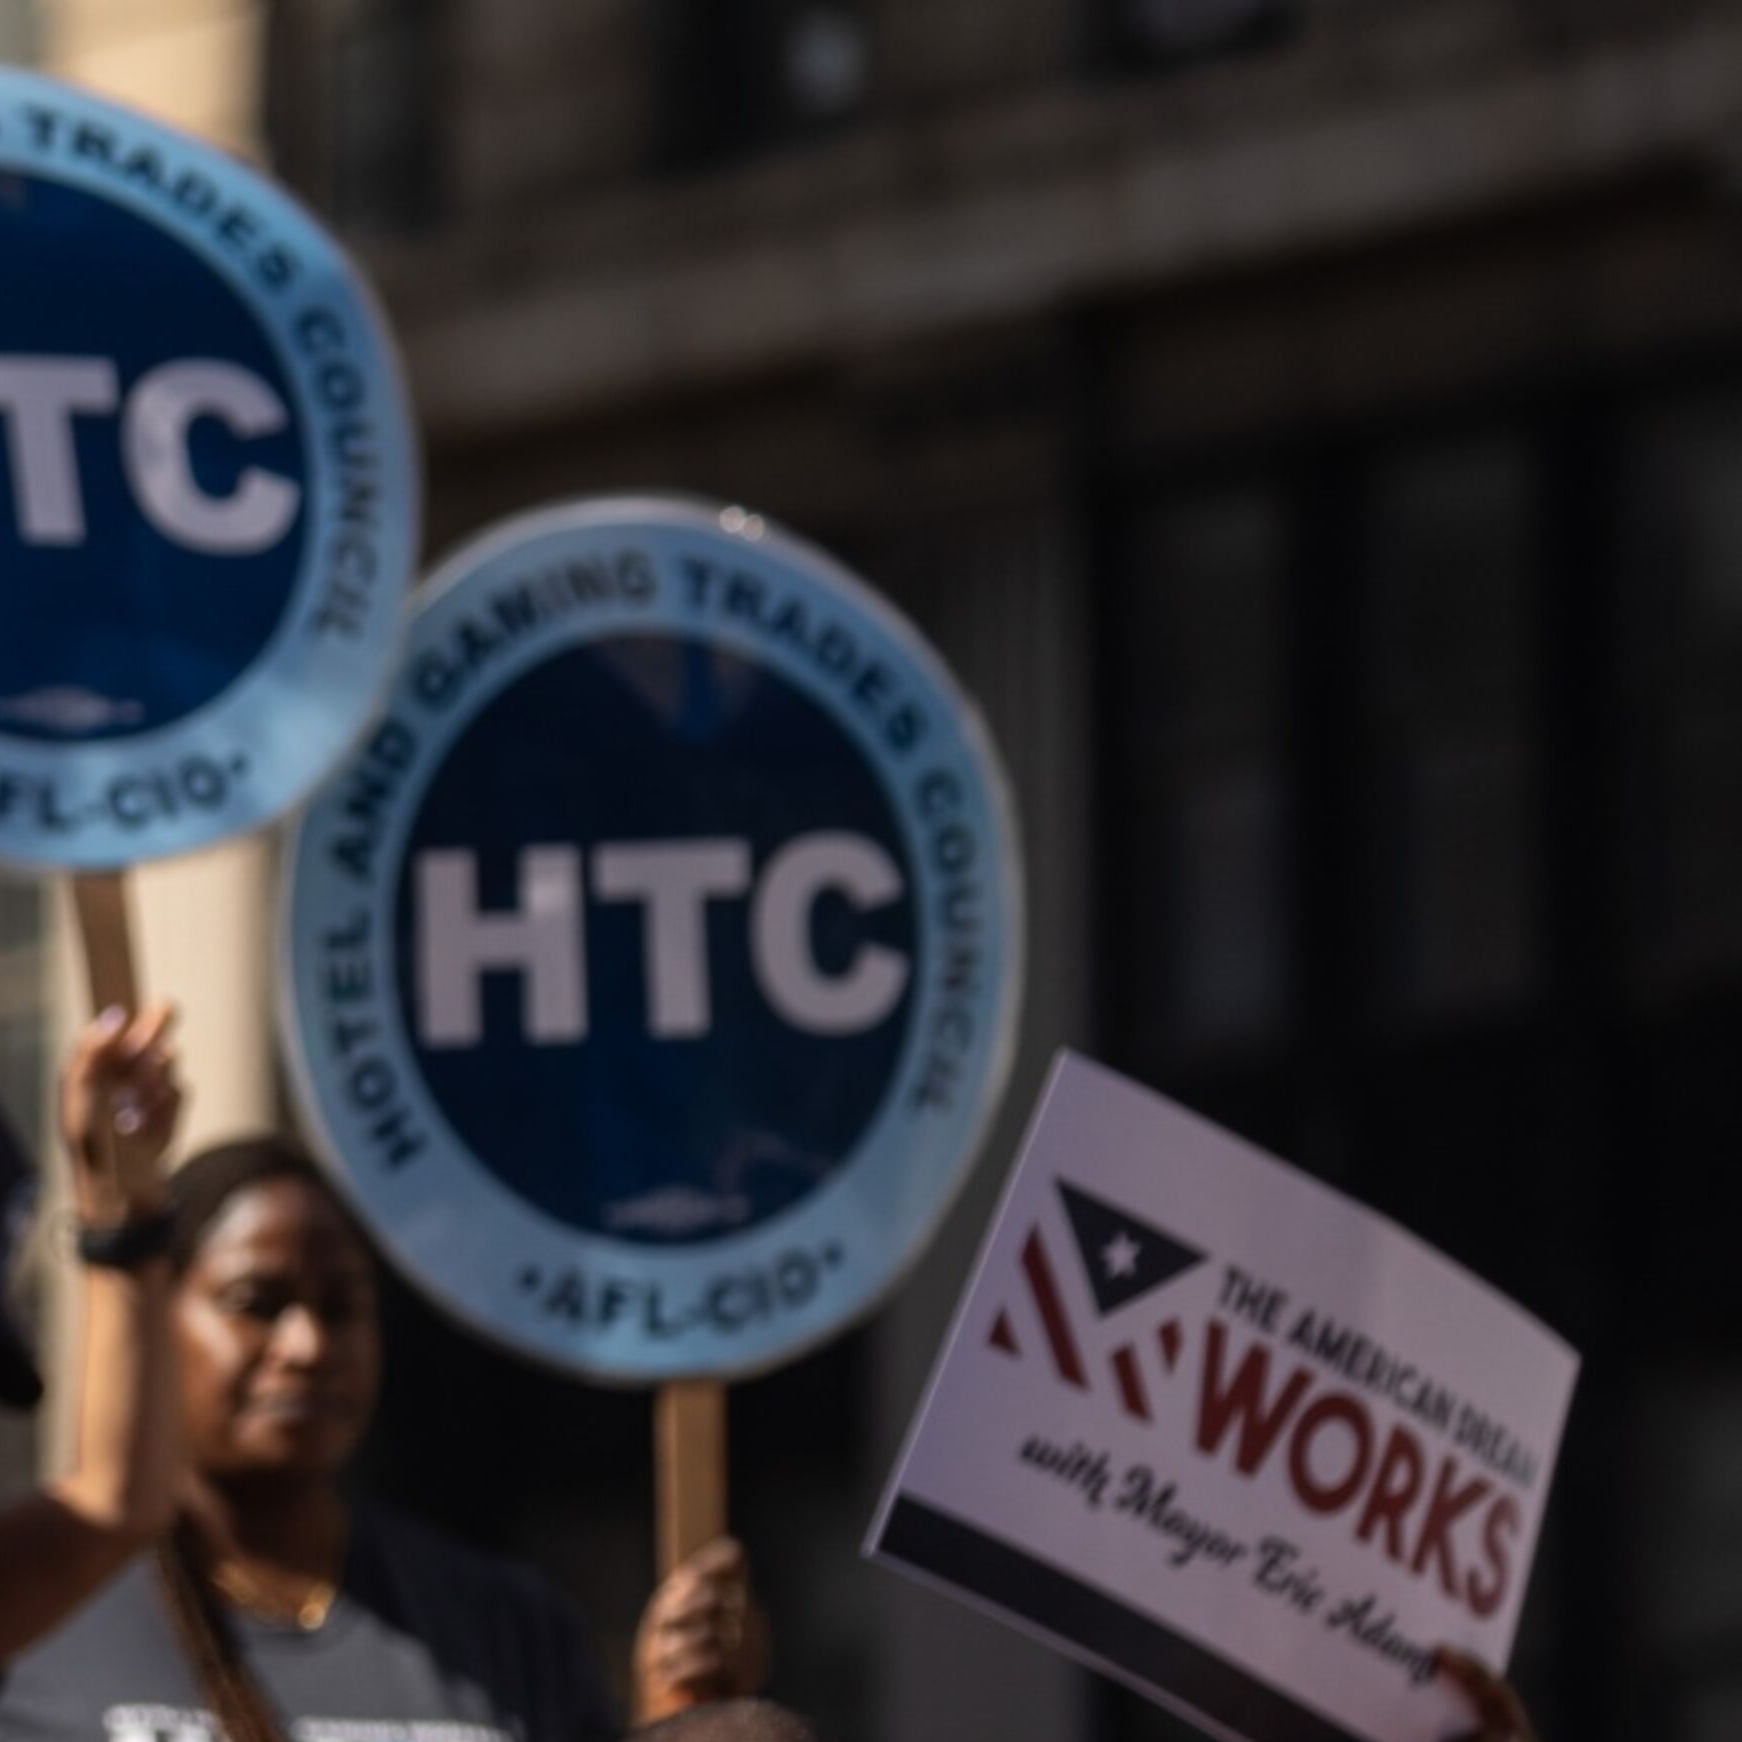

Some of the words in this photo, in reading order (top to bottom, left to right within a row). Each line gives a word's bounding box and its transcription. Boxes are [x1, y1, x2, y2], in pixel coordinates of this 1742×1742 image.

[21, 104, 300, 293] TRADES
[293, 303, 387, 643] COUNCIL
[414, 548, 658, 706] GAMING
[678, 554, 930, 762] TRADES
[331, 715, 420, 881] AND
[322, 898, 430, 1174] HOTEL
[409, 829, 910, 1048] HTC
[914, 768, 982, 1116] COUNCIL
[548, 1250, 830, 1343] AFL-CIO
[1215, 1264, 1290, 1328] THE
[1289, 1304, 1458, 1440] AMERICAN
[1018, 1428, 1114, 1509] with
[1114, 1462, 1250, 1576] Mayor
[1251, 1532, 1324, 1616] Eric
[1192, 1314, 1522, 1621] WORKS
